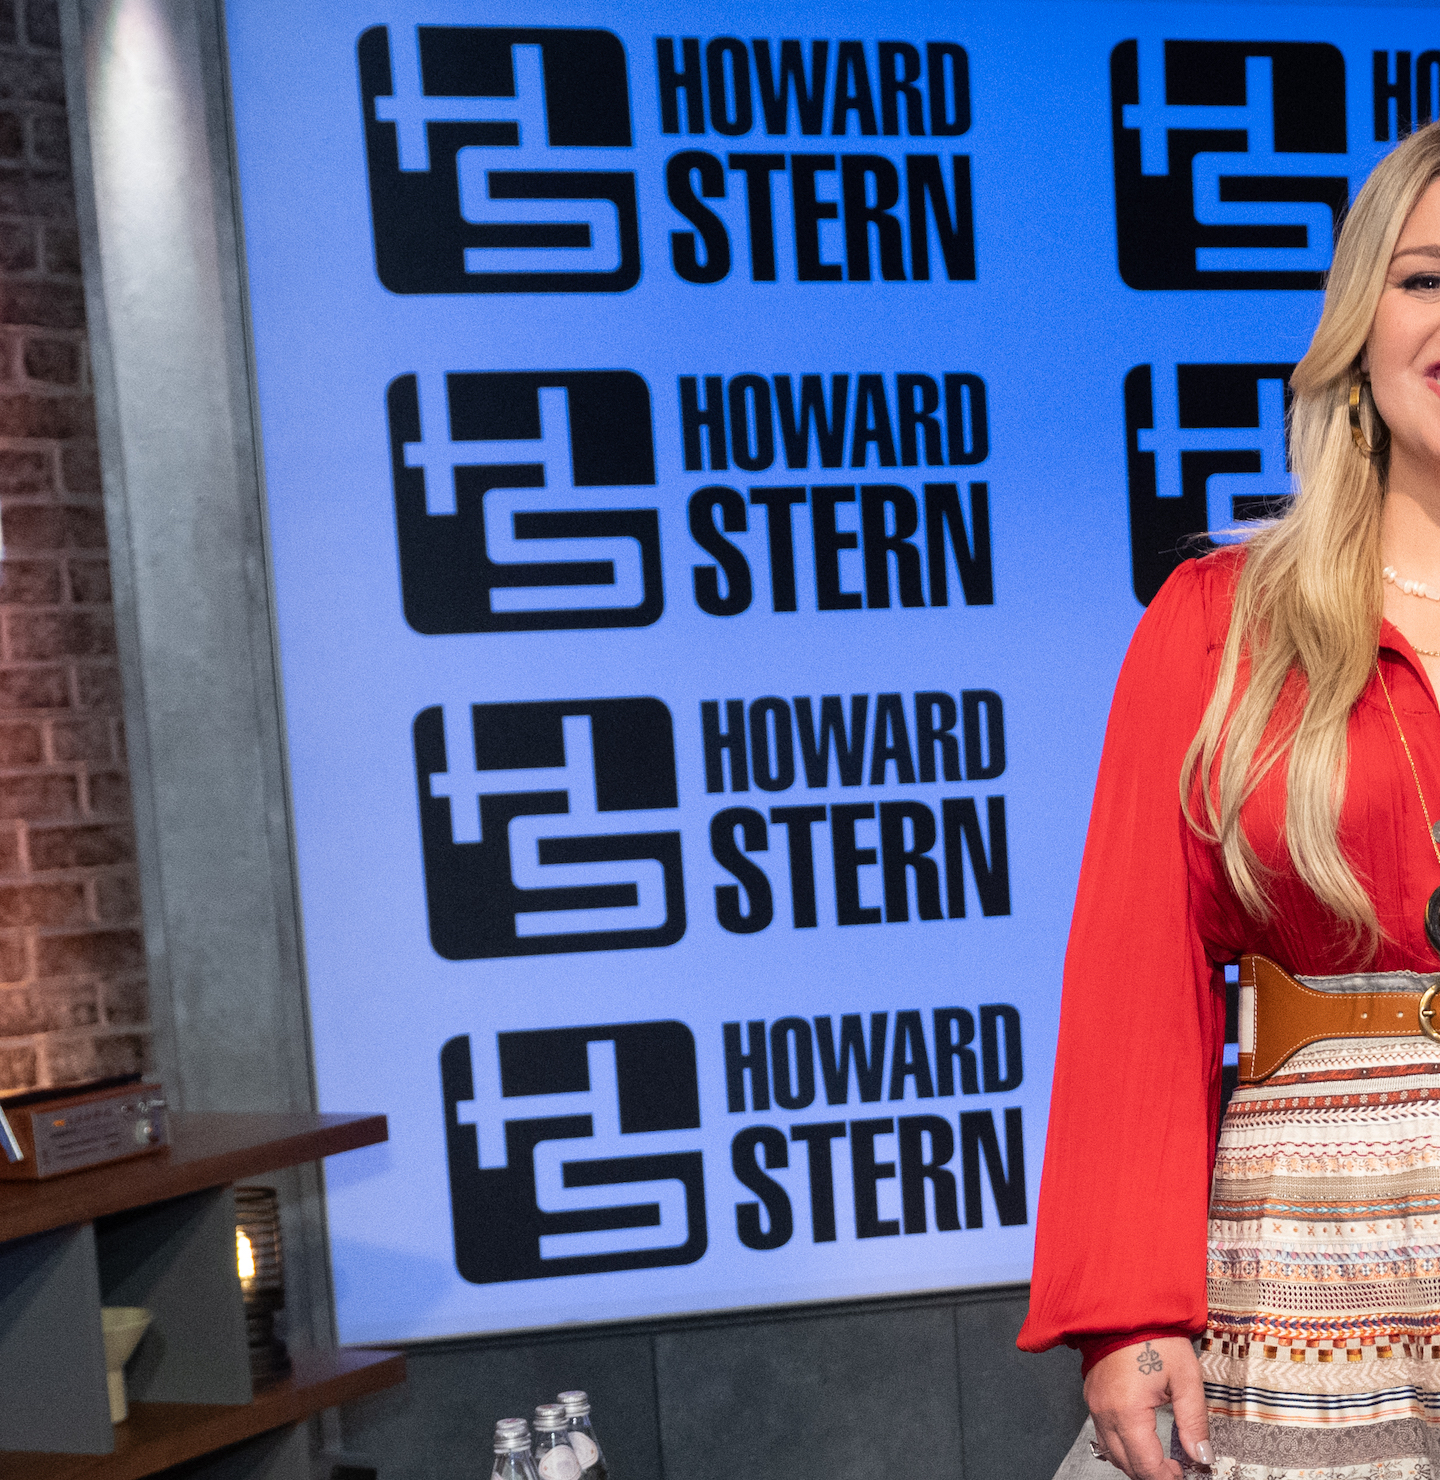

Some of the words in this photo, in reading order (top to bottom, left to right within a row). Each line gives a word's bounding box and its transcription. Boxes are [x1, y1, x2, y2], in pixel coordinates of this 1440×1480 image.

[656, 37, 971, 136] HOWARD
[666, 150, 976, 284] STERN
[679, 372, 988, 471] HOWARD
[688, 481, 993, 616] STERN
[702, 689, 1005, 793] HOWARD
[709, 796, 1011, 934] STERN
[723, 1004, 1023, 1113] HOWARD
[731, 1107, 1028, 1250] STERN
